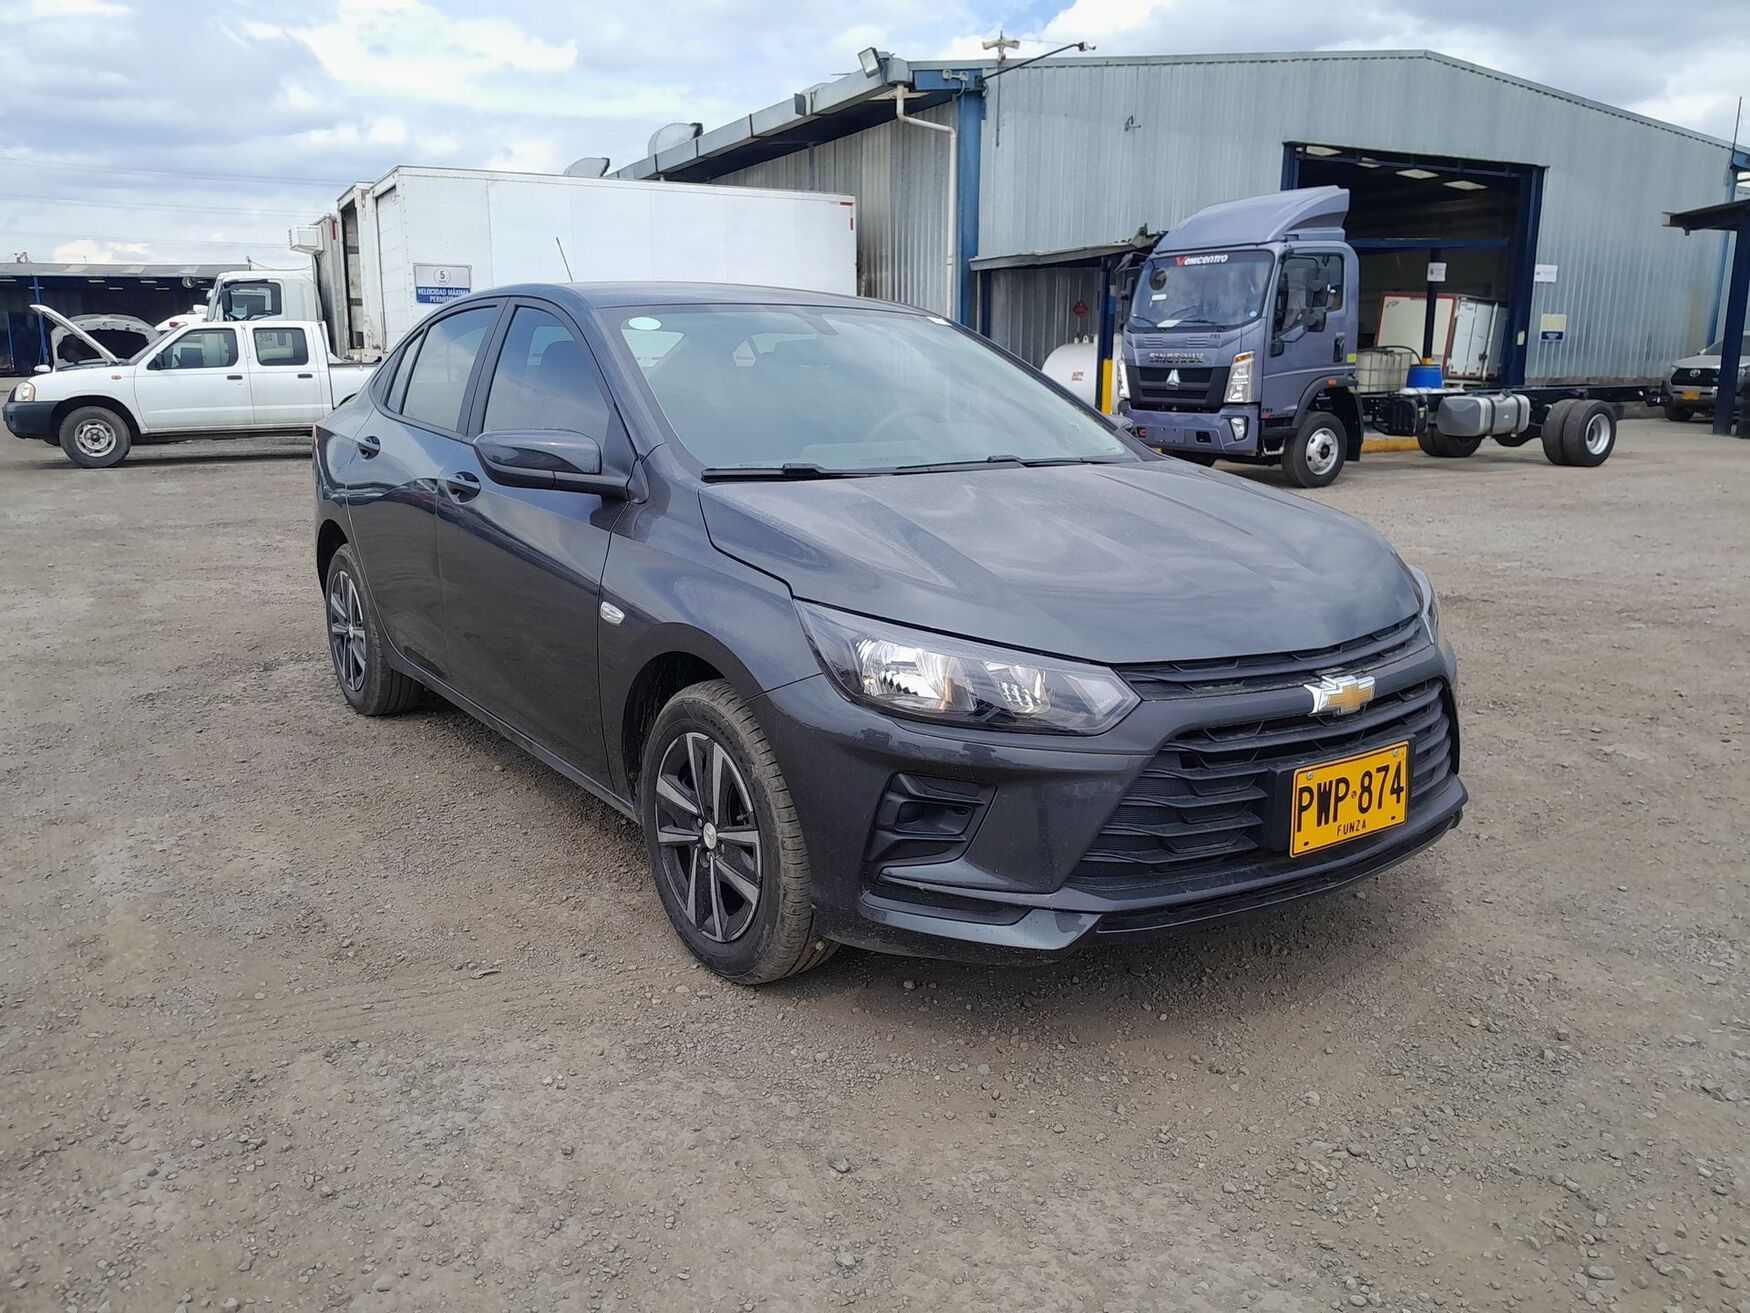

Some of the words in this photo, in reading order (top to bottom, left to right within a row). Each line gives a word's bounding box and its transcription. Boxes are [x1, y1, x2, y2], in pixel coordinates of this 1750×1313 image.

[439, 270, 446, 280] 5
[417, 288, 447, 296] VELOCIDAD
[1336, 819, 1367, 837] FUNZA
